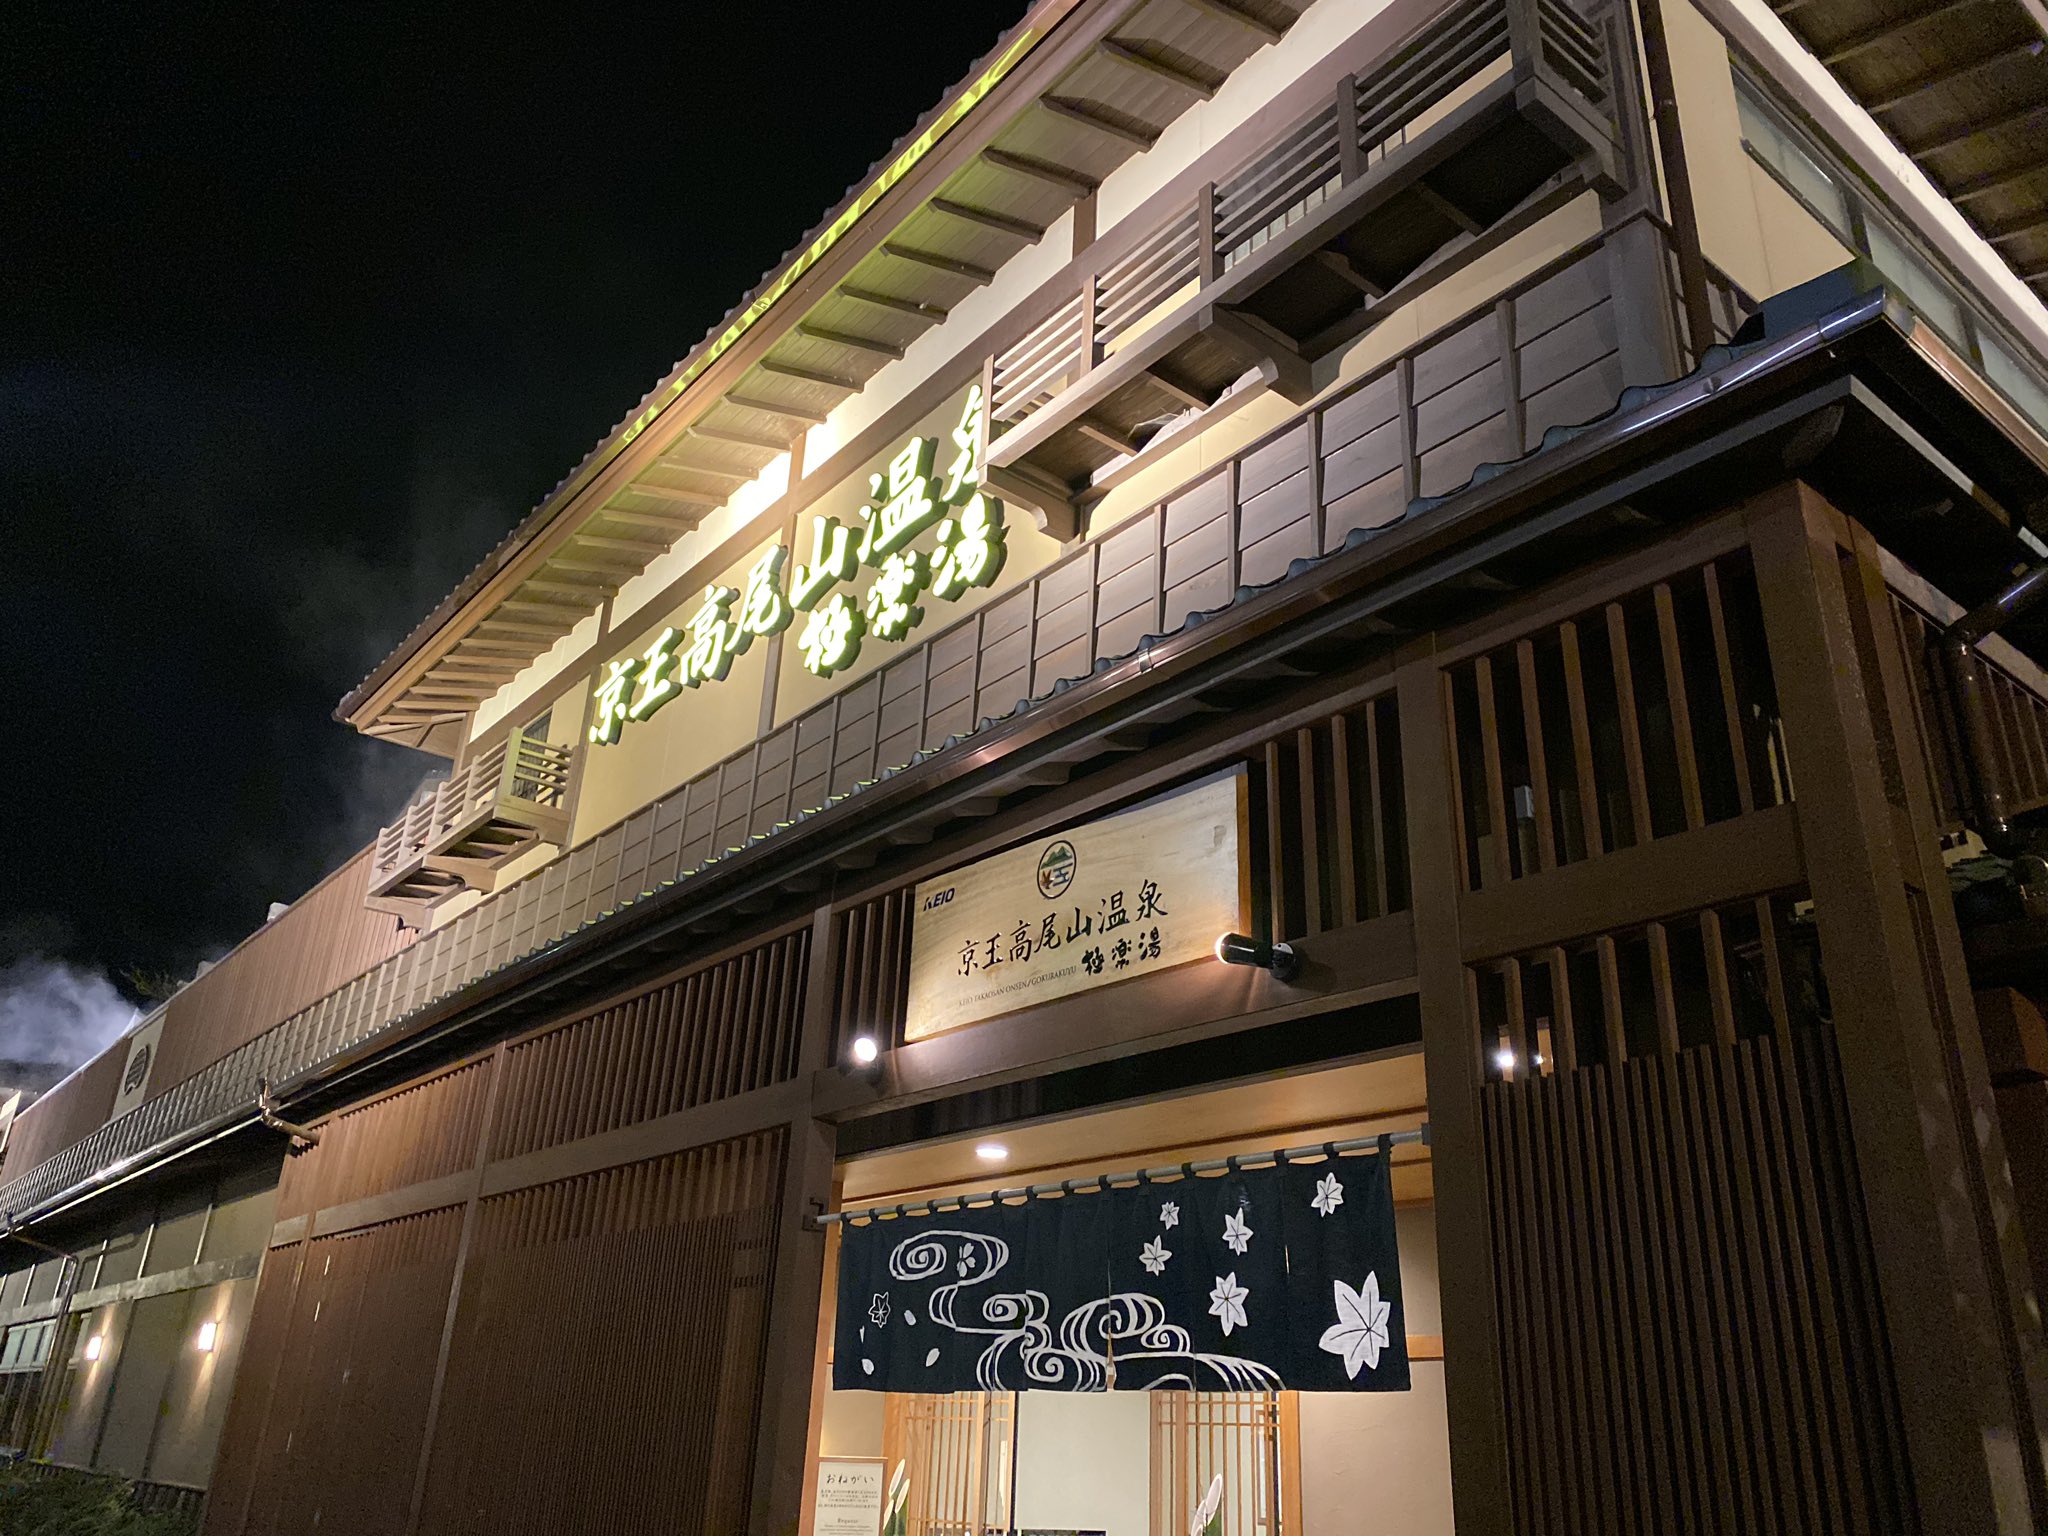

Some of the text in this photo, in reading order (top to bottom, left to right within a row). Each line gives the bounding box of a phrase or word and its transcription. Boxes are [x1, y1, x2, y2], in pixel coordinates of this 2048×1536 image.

[797, 492, 998, 677] 極楽湯
[923, 887, 955, 912] KEIO
[957, 879, 1169, 976] 京王高尾山温泉
[1081, 926, 1161, 976] 極楽湯
[974, 986, 1005, 1003] TAKAOSAN
[826, 1474, 874, 1485] おねがい
